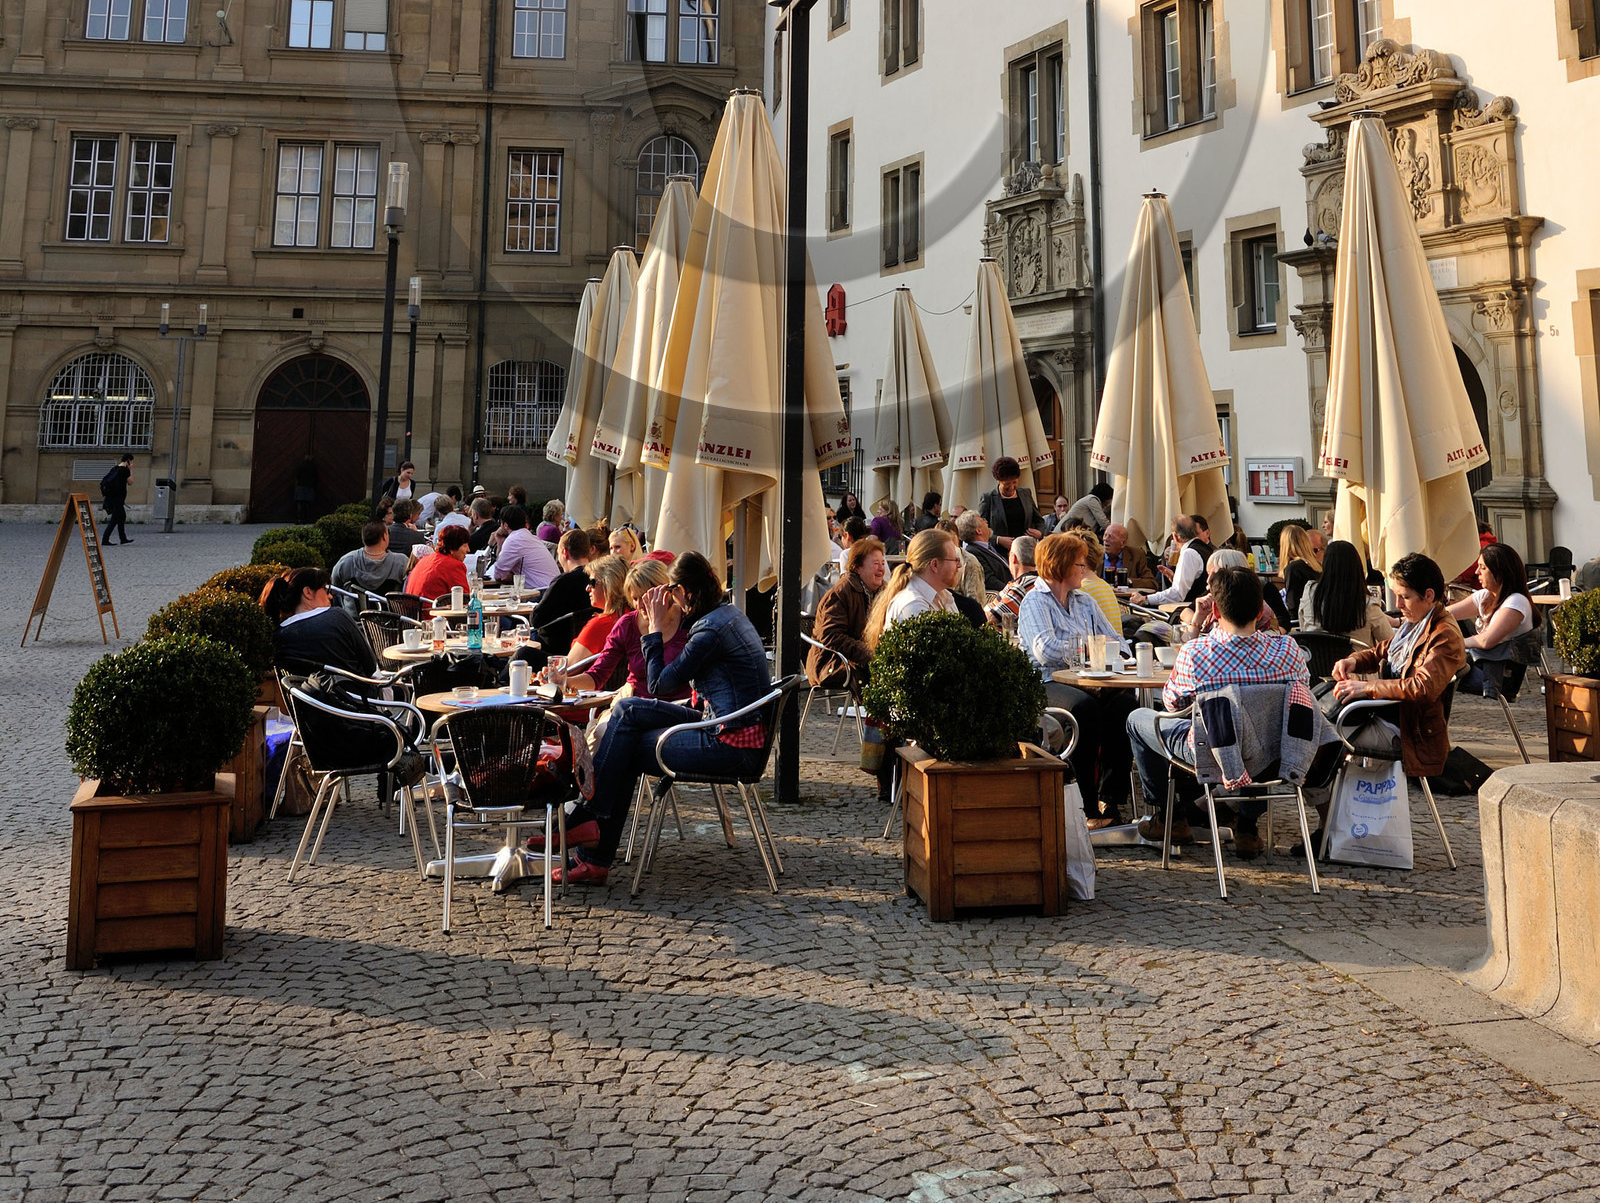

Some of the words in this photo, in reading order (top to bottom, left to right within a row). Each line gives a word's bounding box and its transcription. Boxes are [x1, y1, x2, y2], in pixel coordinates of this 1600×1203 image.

[876, 454, 891, 462] ALTE
[920, 452, 938, 462] ALTE
[958, 455, 977, 463] ALTE
[1190, 451, 1217, 464] ALTE
